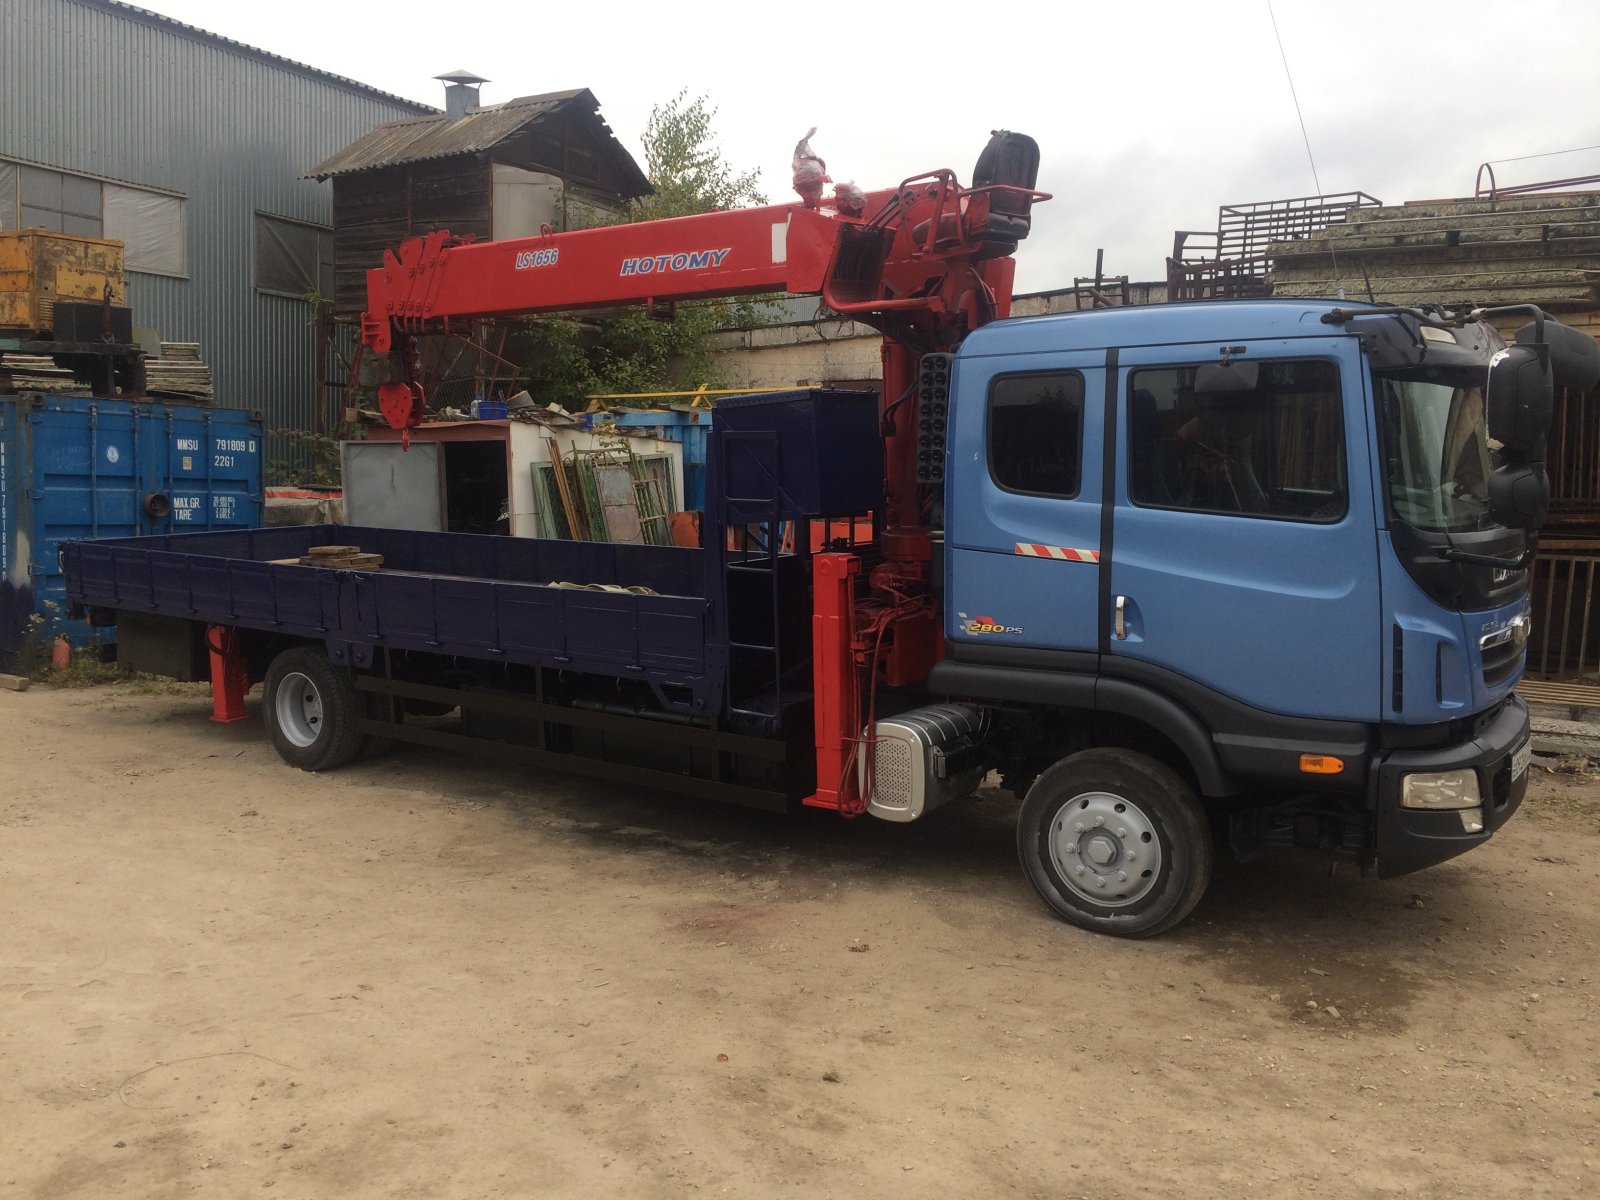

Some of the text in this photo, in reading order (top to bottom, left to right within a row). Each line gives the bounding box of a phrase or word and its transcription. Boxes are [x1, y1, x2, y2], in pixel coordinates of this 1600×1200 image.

[515, 248, 559, 270] LS1656
[619, 247, 732, 277] HOTOMY
[216, 439, 246, 452] 791809
[214, 455, 235, 467] 22G1
[174, 509, 193, 520] TARE
